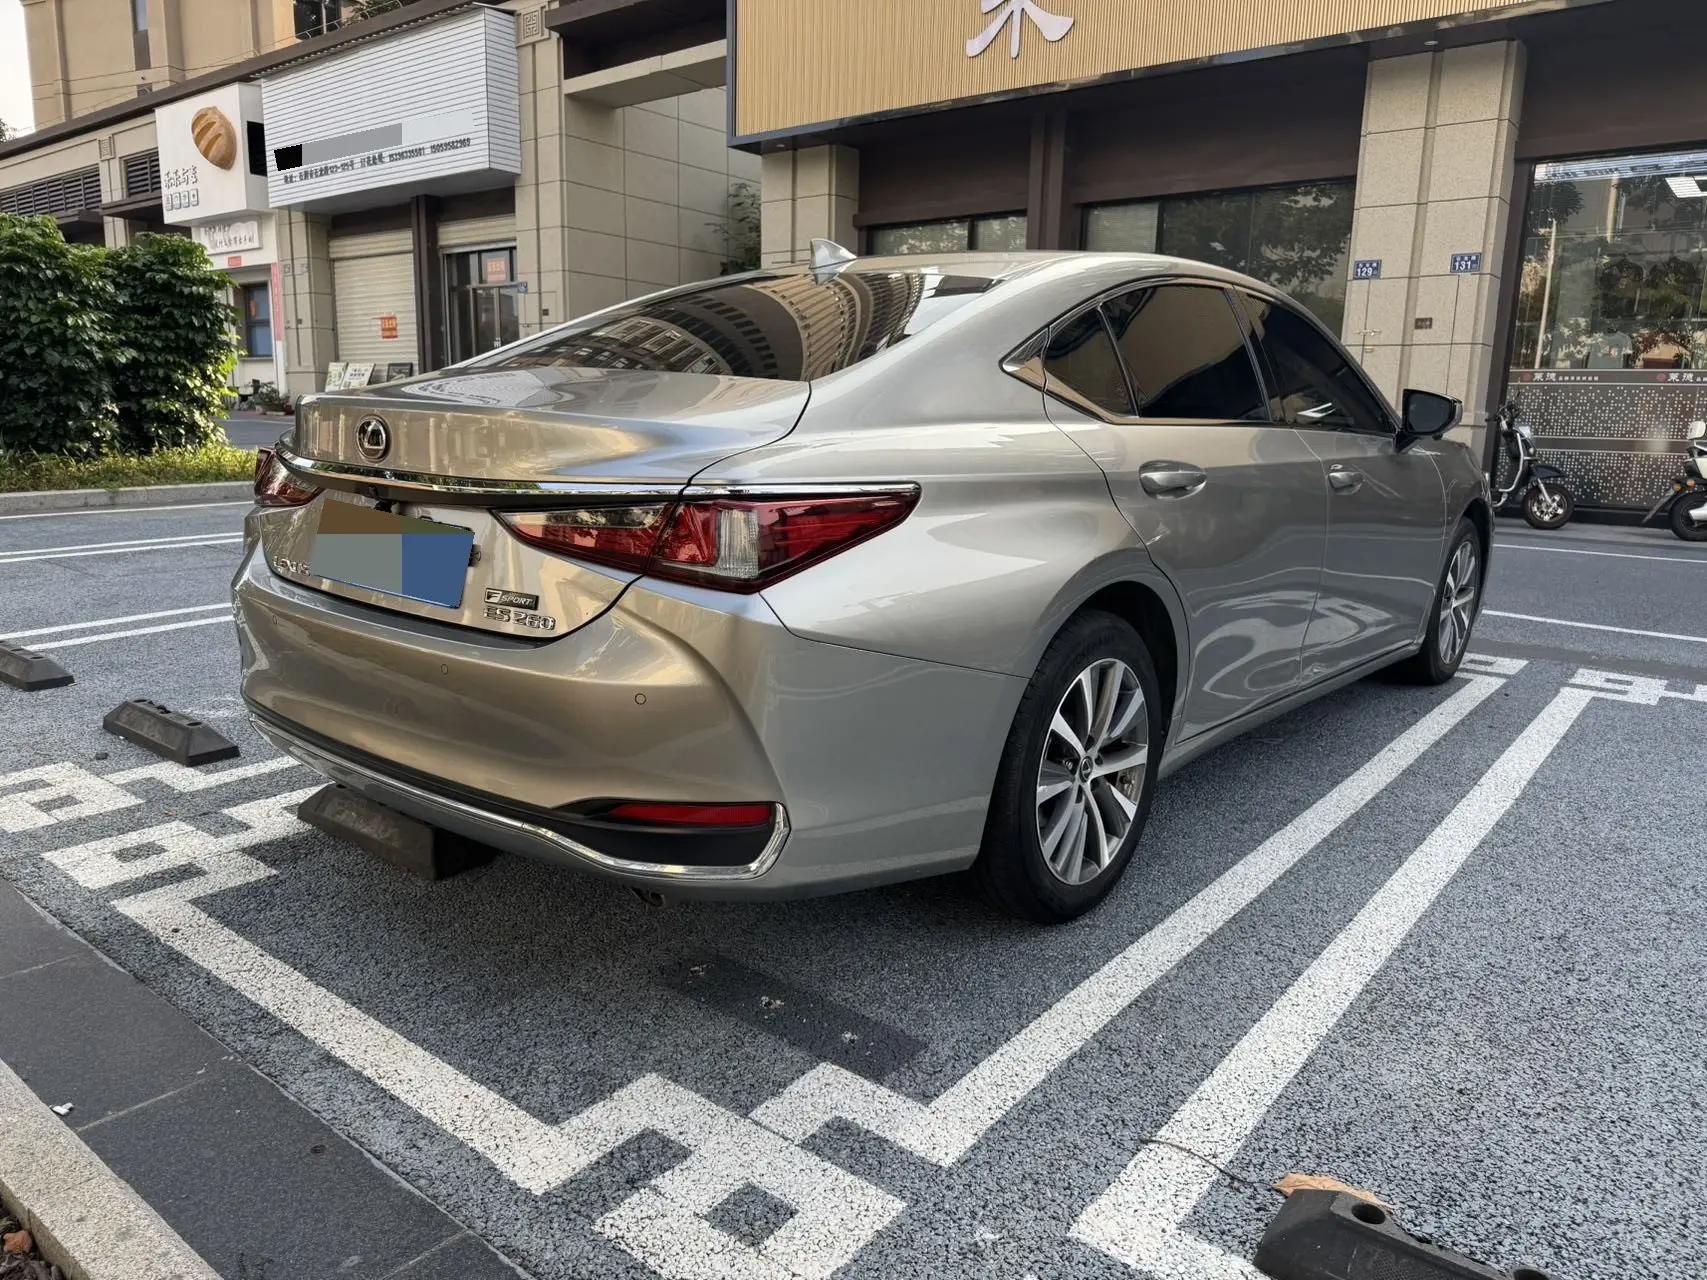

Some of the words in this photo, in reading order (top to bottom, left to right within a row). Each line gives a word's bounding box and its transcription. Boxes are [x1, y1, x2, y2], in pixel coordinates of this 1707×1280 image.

[501, 594, 532, 606] SPORT
[484, 606, 511, 622] ES
[512, 611, 556, 630] 260
